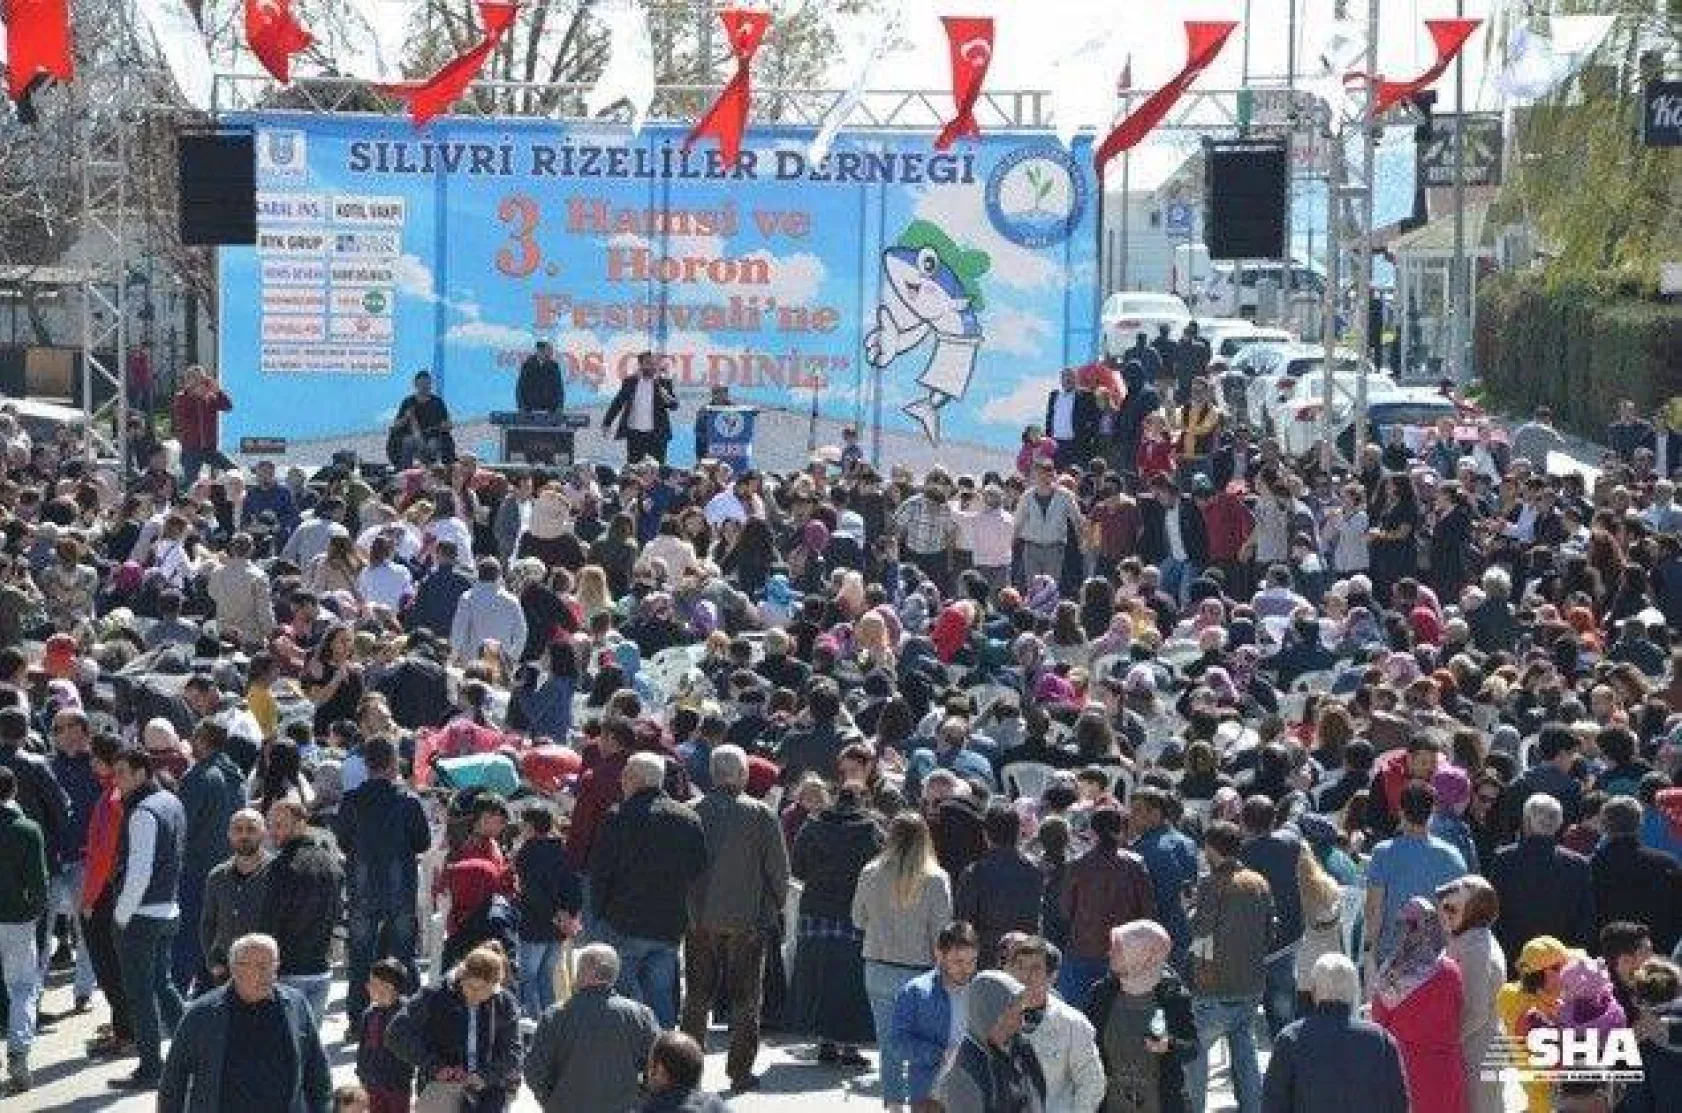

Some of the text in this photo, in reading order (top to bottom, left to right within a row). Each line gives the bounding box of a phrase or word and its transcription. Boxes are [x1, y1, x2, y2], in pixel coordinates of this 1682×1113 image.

[350, 132, 513, 176] SİLİVRİ
[531, 137, 758, 180] RİZELİLER
[496, 194, 811, 277] 3. Hamsi ve
[606, 248, 770, 284] Horon
